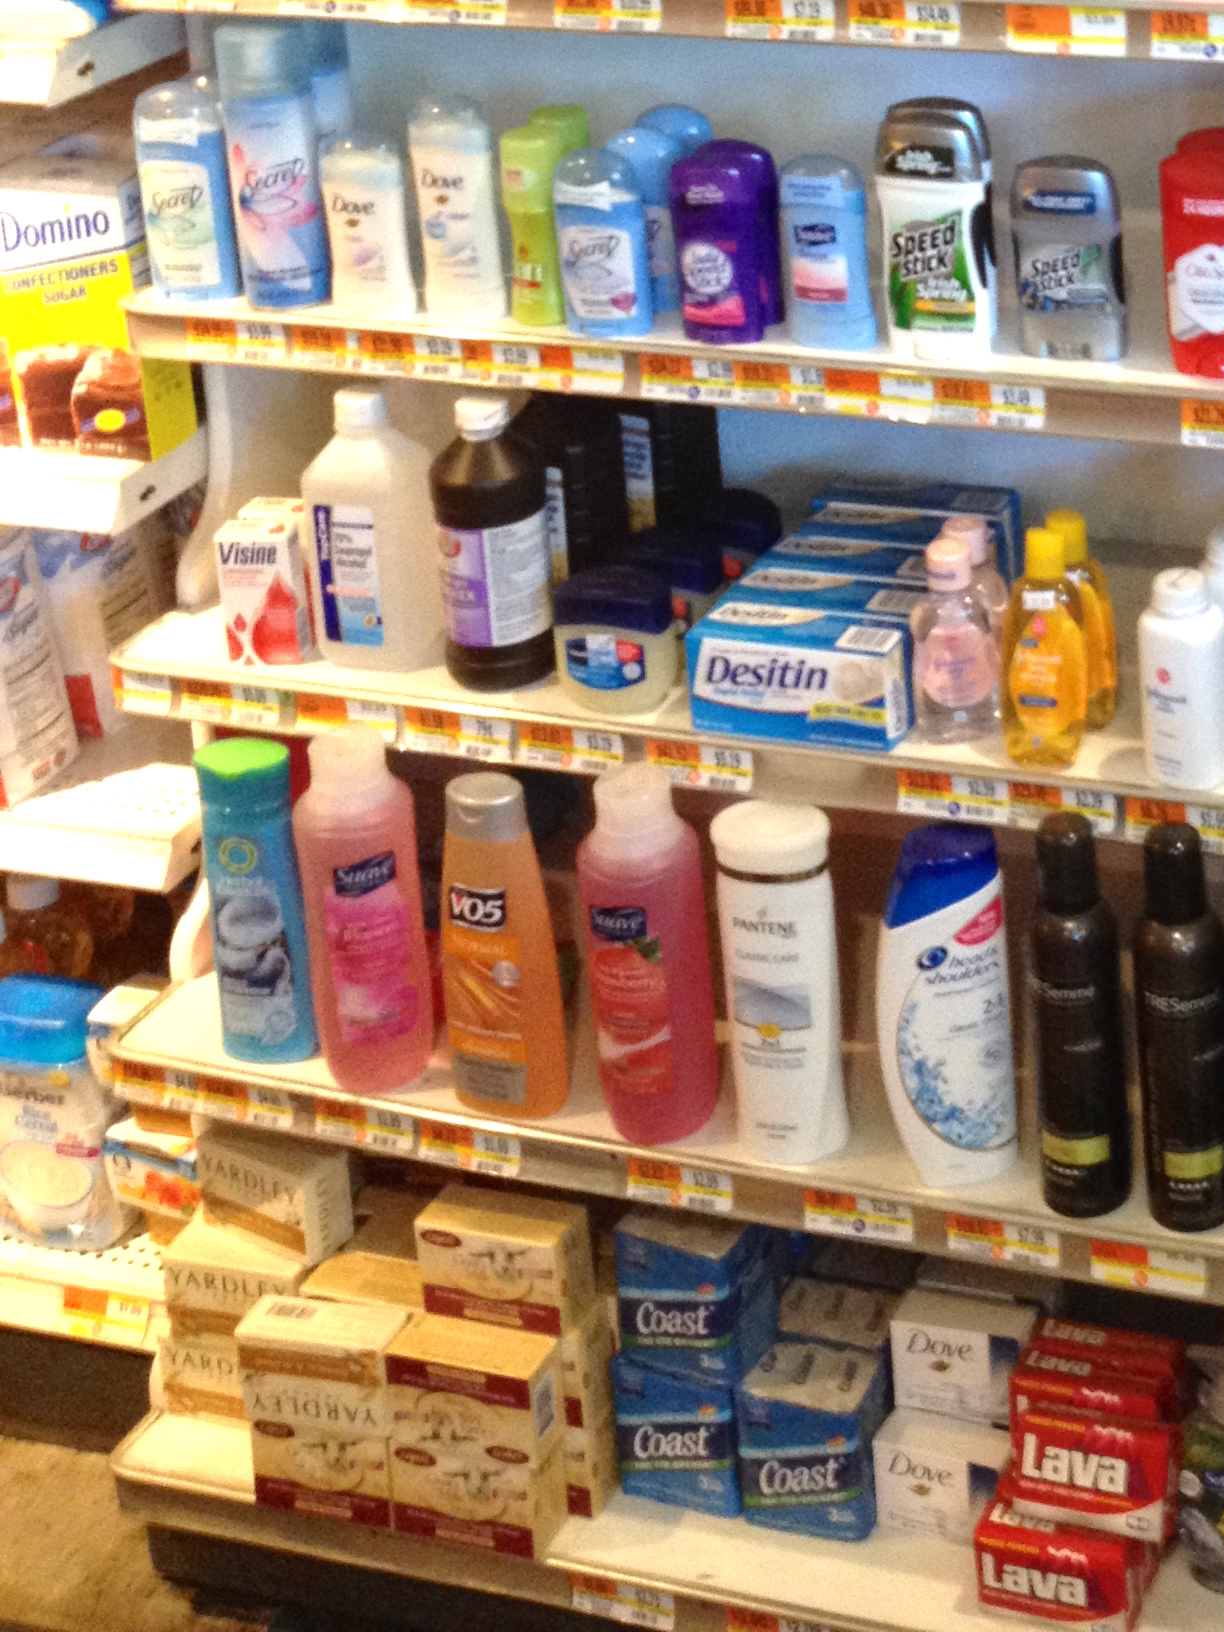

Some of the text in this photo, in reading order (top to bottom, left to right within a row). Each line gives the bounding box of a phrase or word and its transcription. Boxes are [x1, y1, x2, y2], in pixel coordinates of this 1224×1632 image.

[421, 170, 465, 190] Dove
[331, 192, 375, 216] Dove
[1, 206, 111, 254] Domino
[42, 283, 88, 304] SUGAR
[218, 542, 278, 566] Visine
[705, 653, 829, 693] Desitin
[449, 889, 503, 926] VO5
[731, 913, 798, 939] PANTENE
[202, 1155, 298, 1203] YARDLEY
[635, 1301, 711, 1337] Coast
[905, 1329, 973, 1361] Dove
[251, 1391, 378, 1428] YARDLEY
[632, 1424, 709, 1459] Coast
[758, 1457, 840, 1494] Coast
[887, 1449, 954, 1484] Dove
[1020, 1431, 1130, 1496] Lava
[982, 1549, 1089, 1608] Lava
